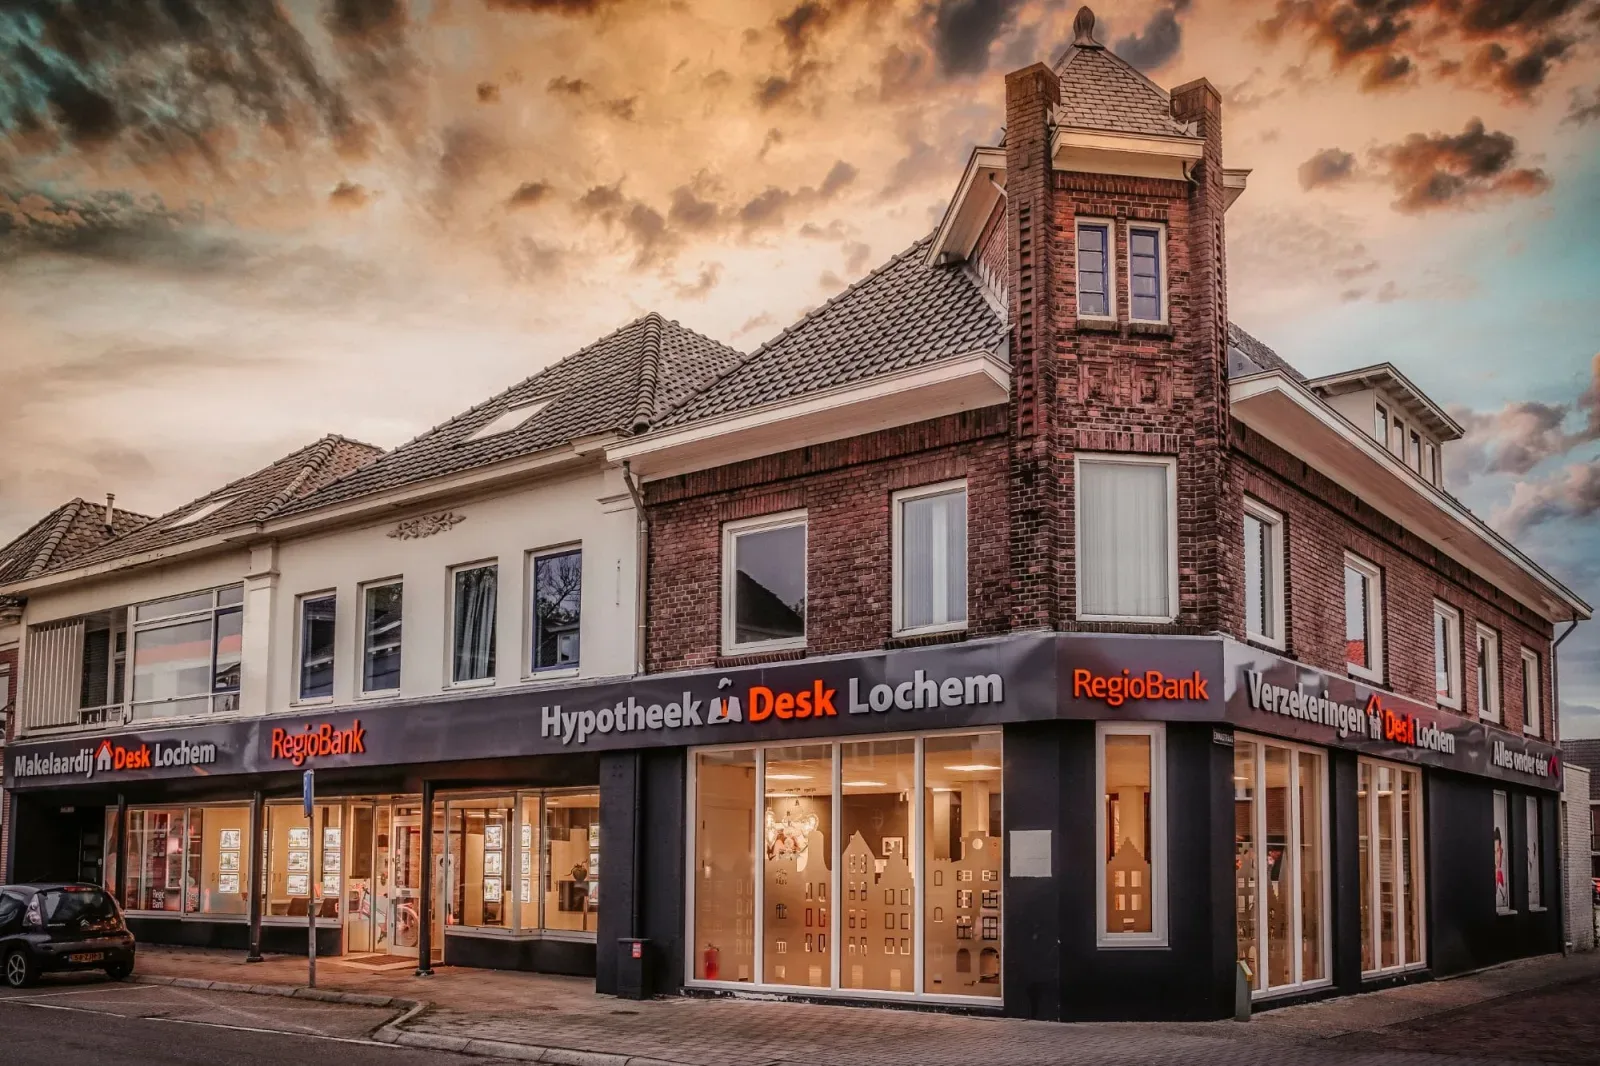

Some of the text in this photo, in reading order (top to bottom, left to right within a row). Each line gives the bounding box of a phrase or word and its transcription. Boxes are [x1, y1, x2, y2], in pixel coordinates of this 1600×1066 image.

[541, 670, 1003, 745] Hypotheek Desk Lochem
[1074, 668, 1209, 706] RegioBank
[1248, 669, 1456, 754] Verzekeringen Desk Lochem
[14, 740, 216, 779] Makelaardij Desk Lochem
[271, 719, 365, 766] RegioBank
[1493, 740, 1513, 769] Alles
[1514, 749, 1535, 775] onder
